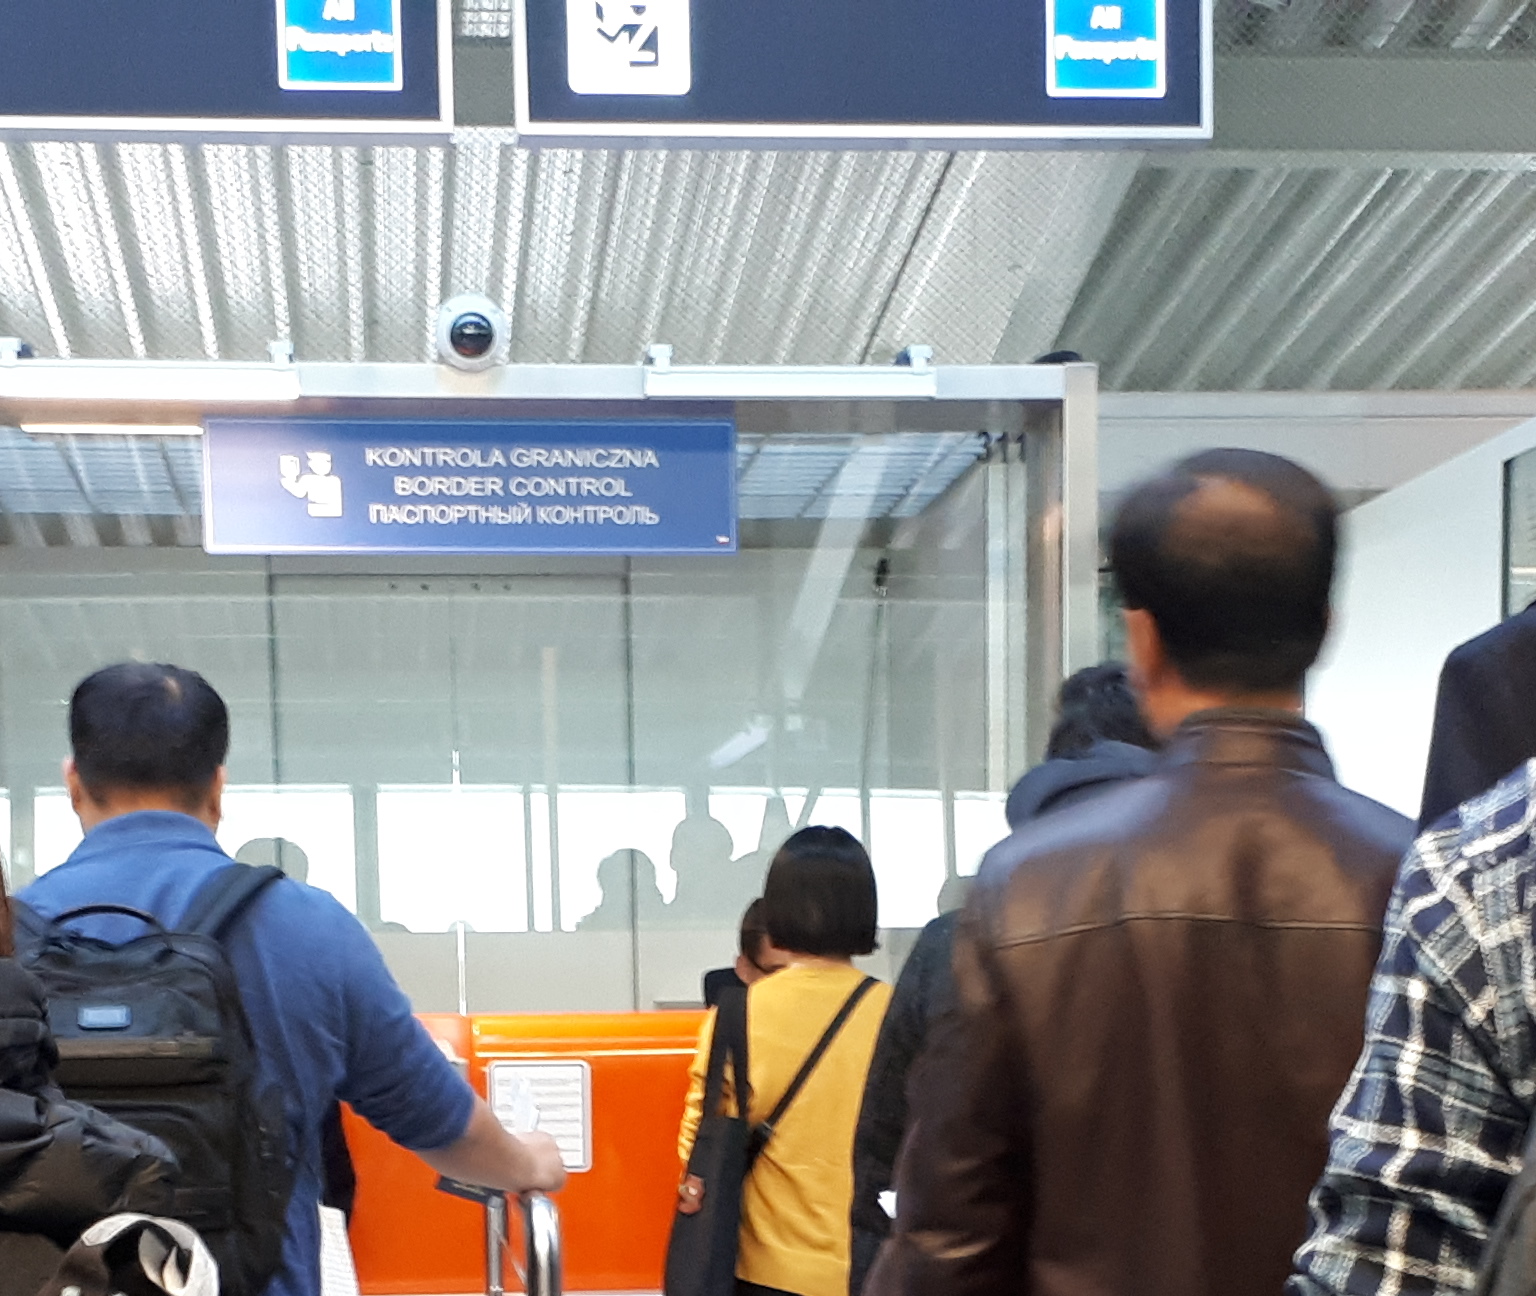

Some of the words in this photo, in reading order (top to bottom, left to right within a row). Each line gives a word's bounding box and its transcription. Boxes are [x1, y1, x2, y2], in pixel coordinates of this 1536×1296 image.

[365, 447, 507, 467] KONTROLA
[509, 447, 660, 468] GRANICZNA
[977, 431, 1027, 463] 311
[393, 475, 505, 497] BORDER
[509, 476, 633, 497] CONTROL
[368, 501, 532, 525] ПАСПОРТНЫЙ
[535, 504, 660, 525] КОНТРОЛЬ
